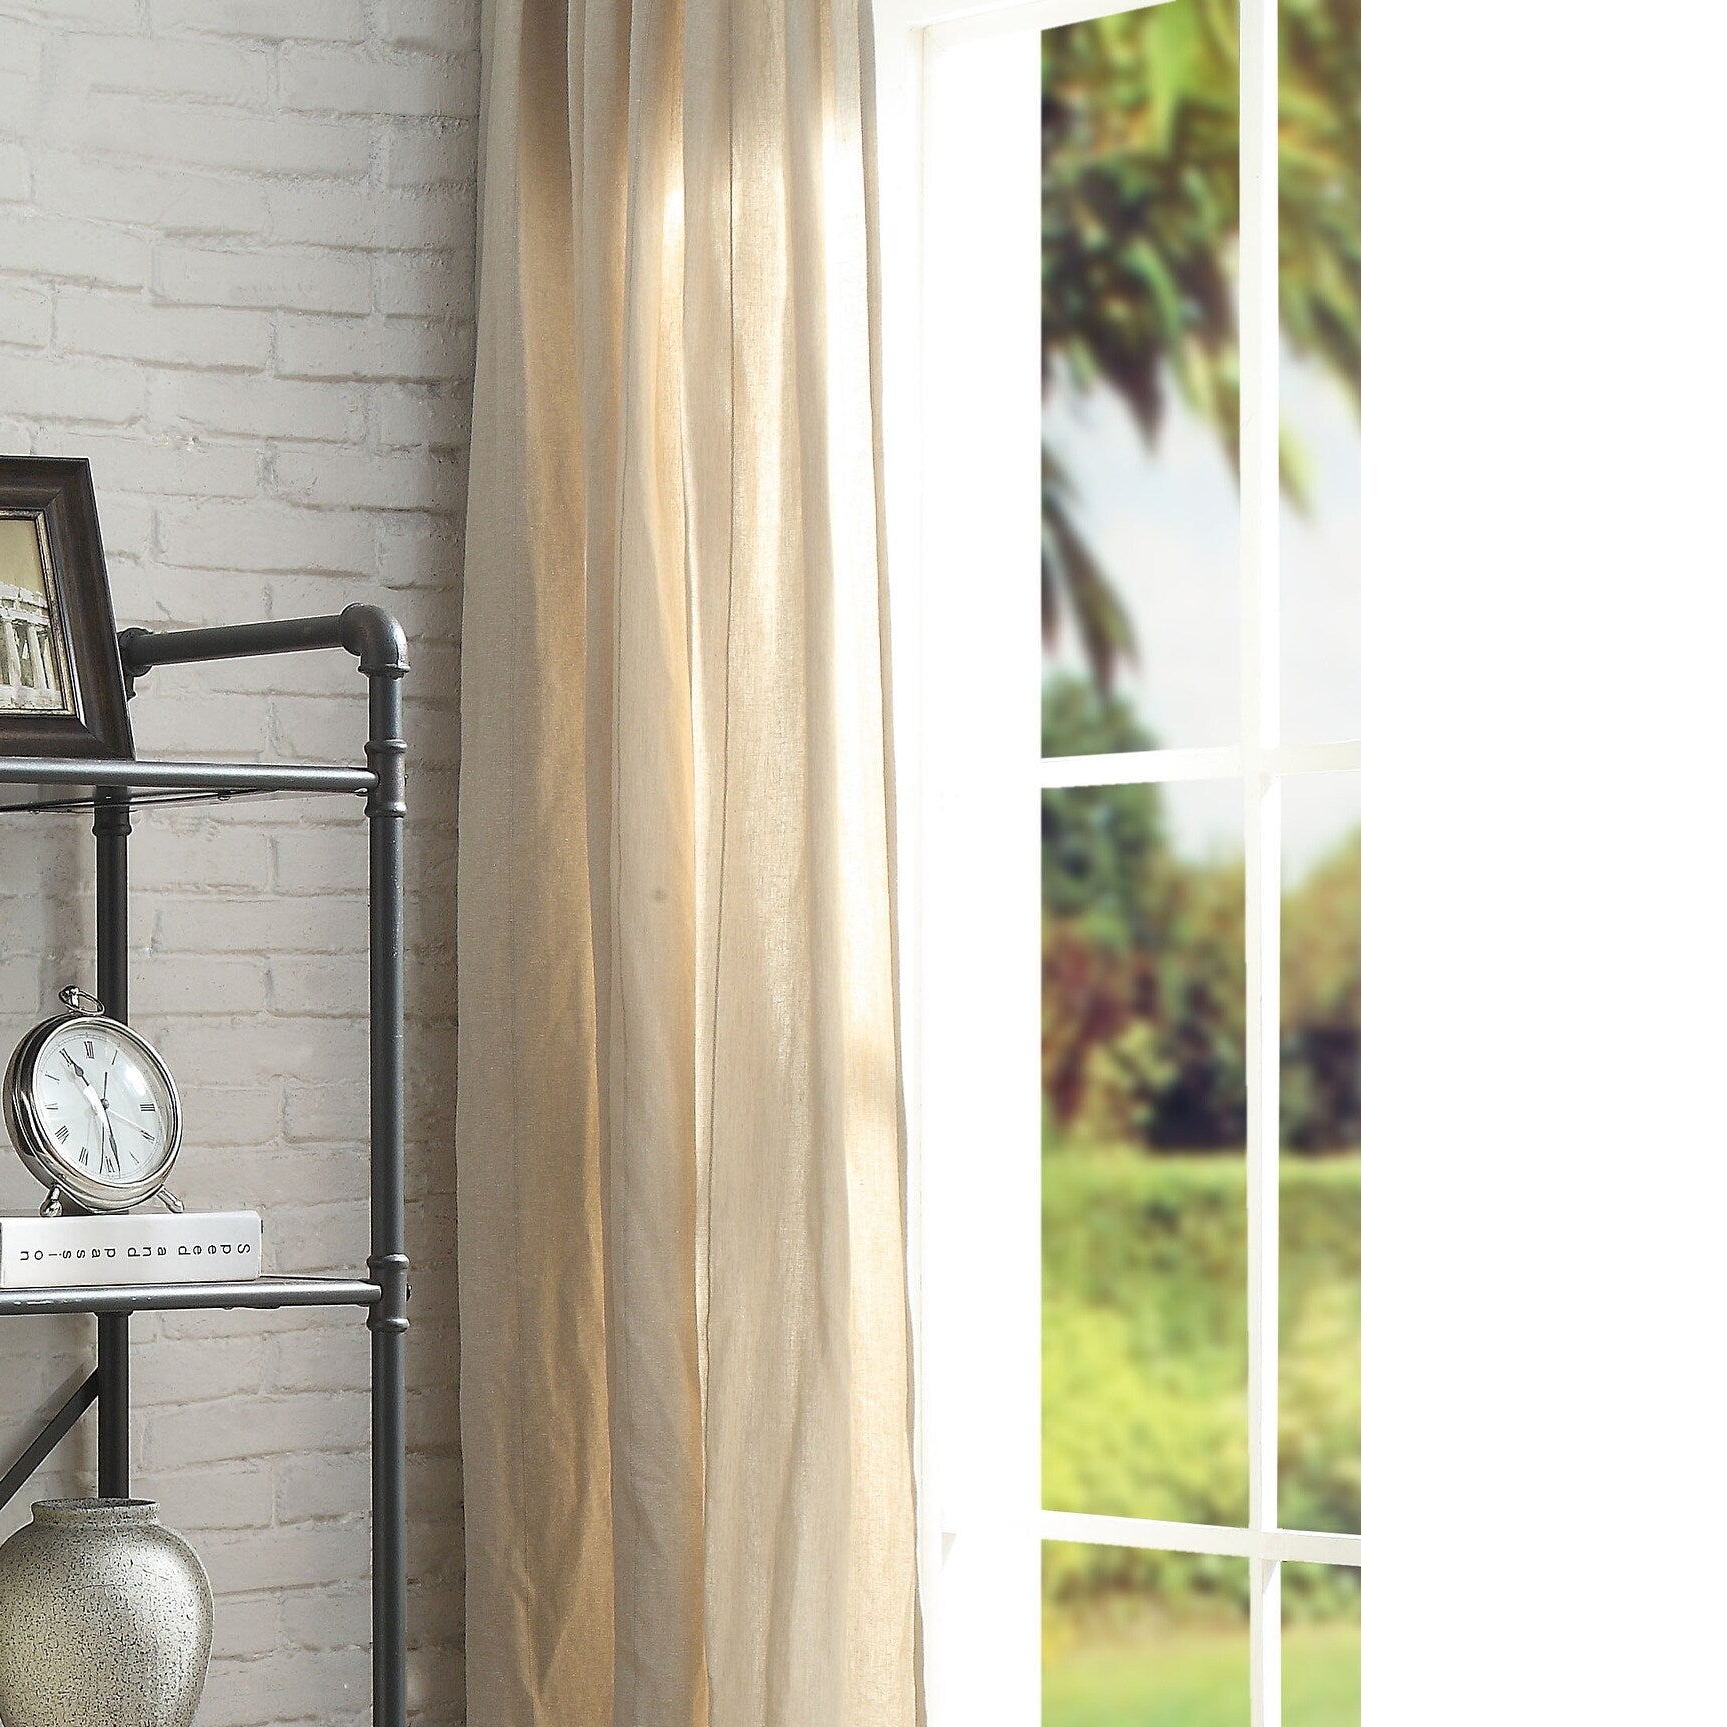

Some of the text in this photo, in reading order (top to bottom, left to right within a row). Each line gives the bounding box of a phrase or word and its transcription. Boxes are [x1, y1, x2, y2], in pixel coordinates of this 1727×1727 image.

[20, 1243, 250, 1261] Speed and passion
